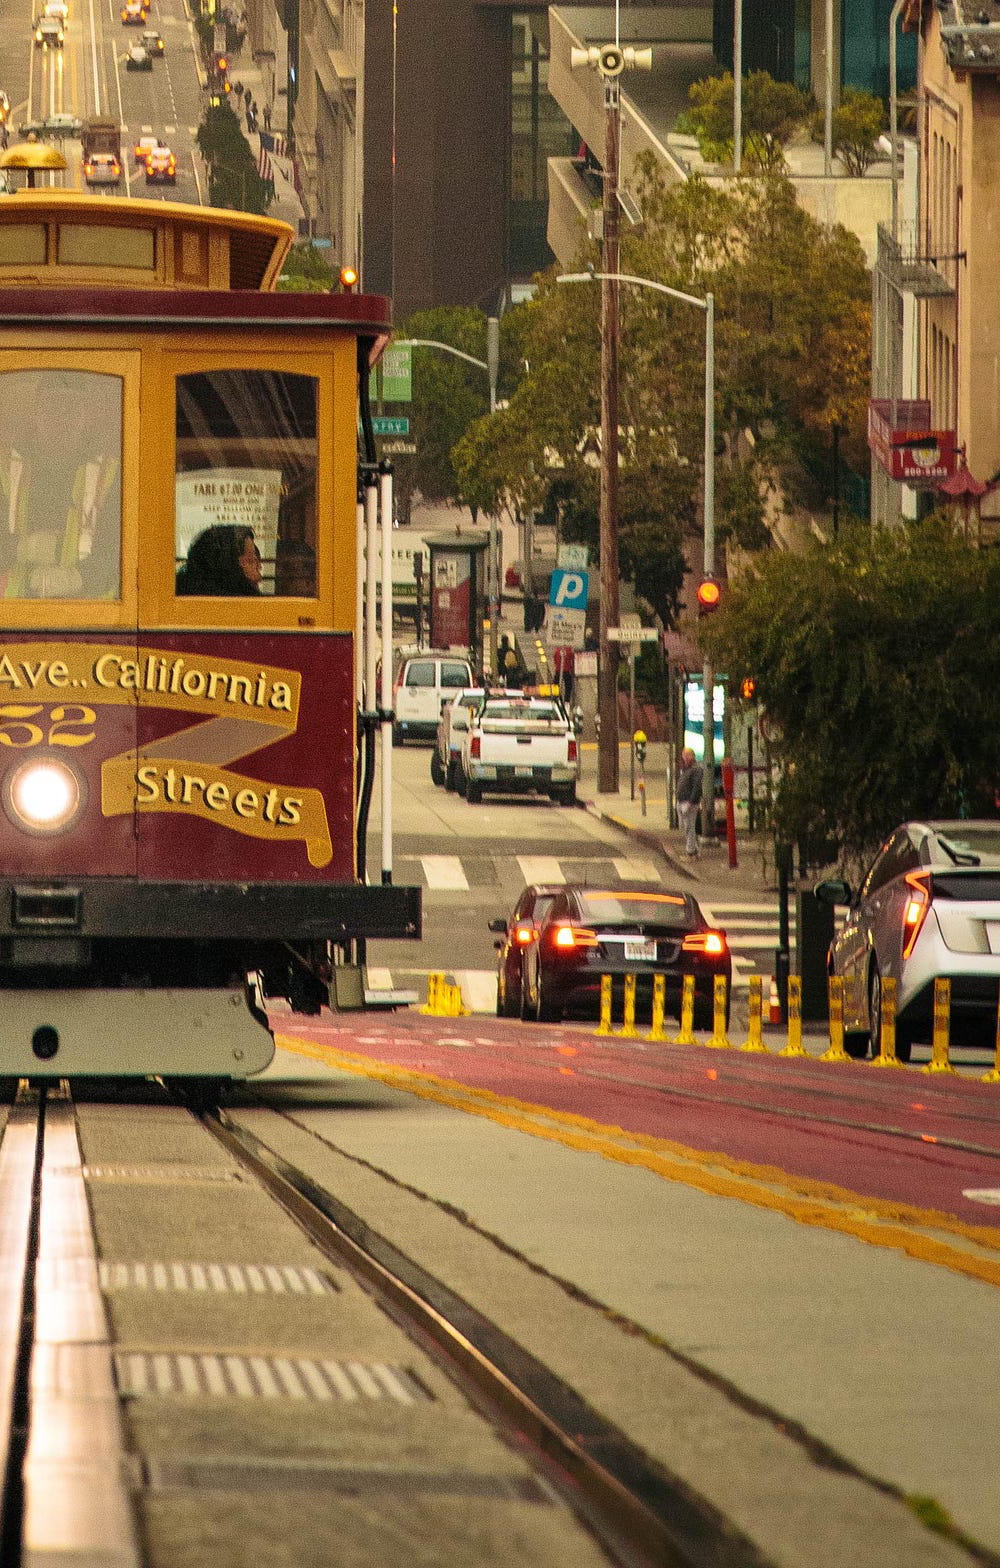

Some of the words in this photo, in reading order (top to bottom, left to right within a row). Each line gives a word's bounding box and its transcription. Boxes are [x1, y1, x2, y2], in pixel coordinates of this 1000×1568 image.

[555, 574, 583, 605] P
[93, 653, 293, 712] California
[134, 766, 304, 826] Streets
